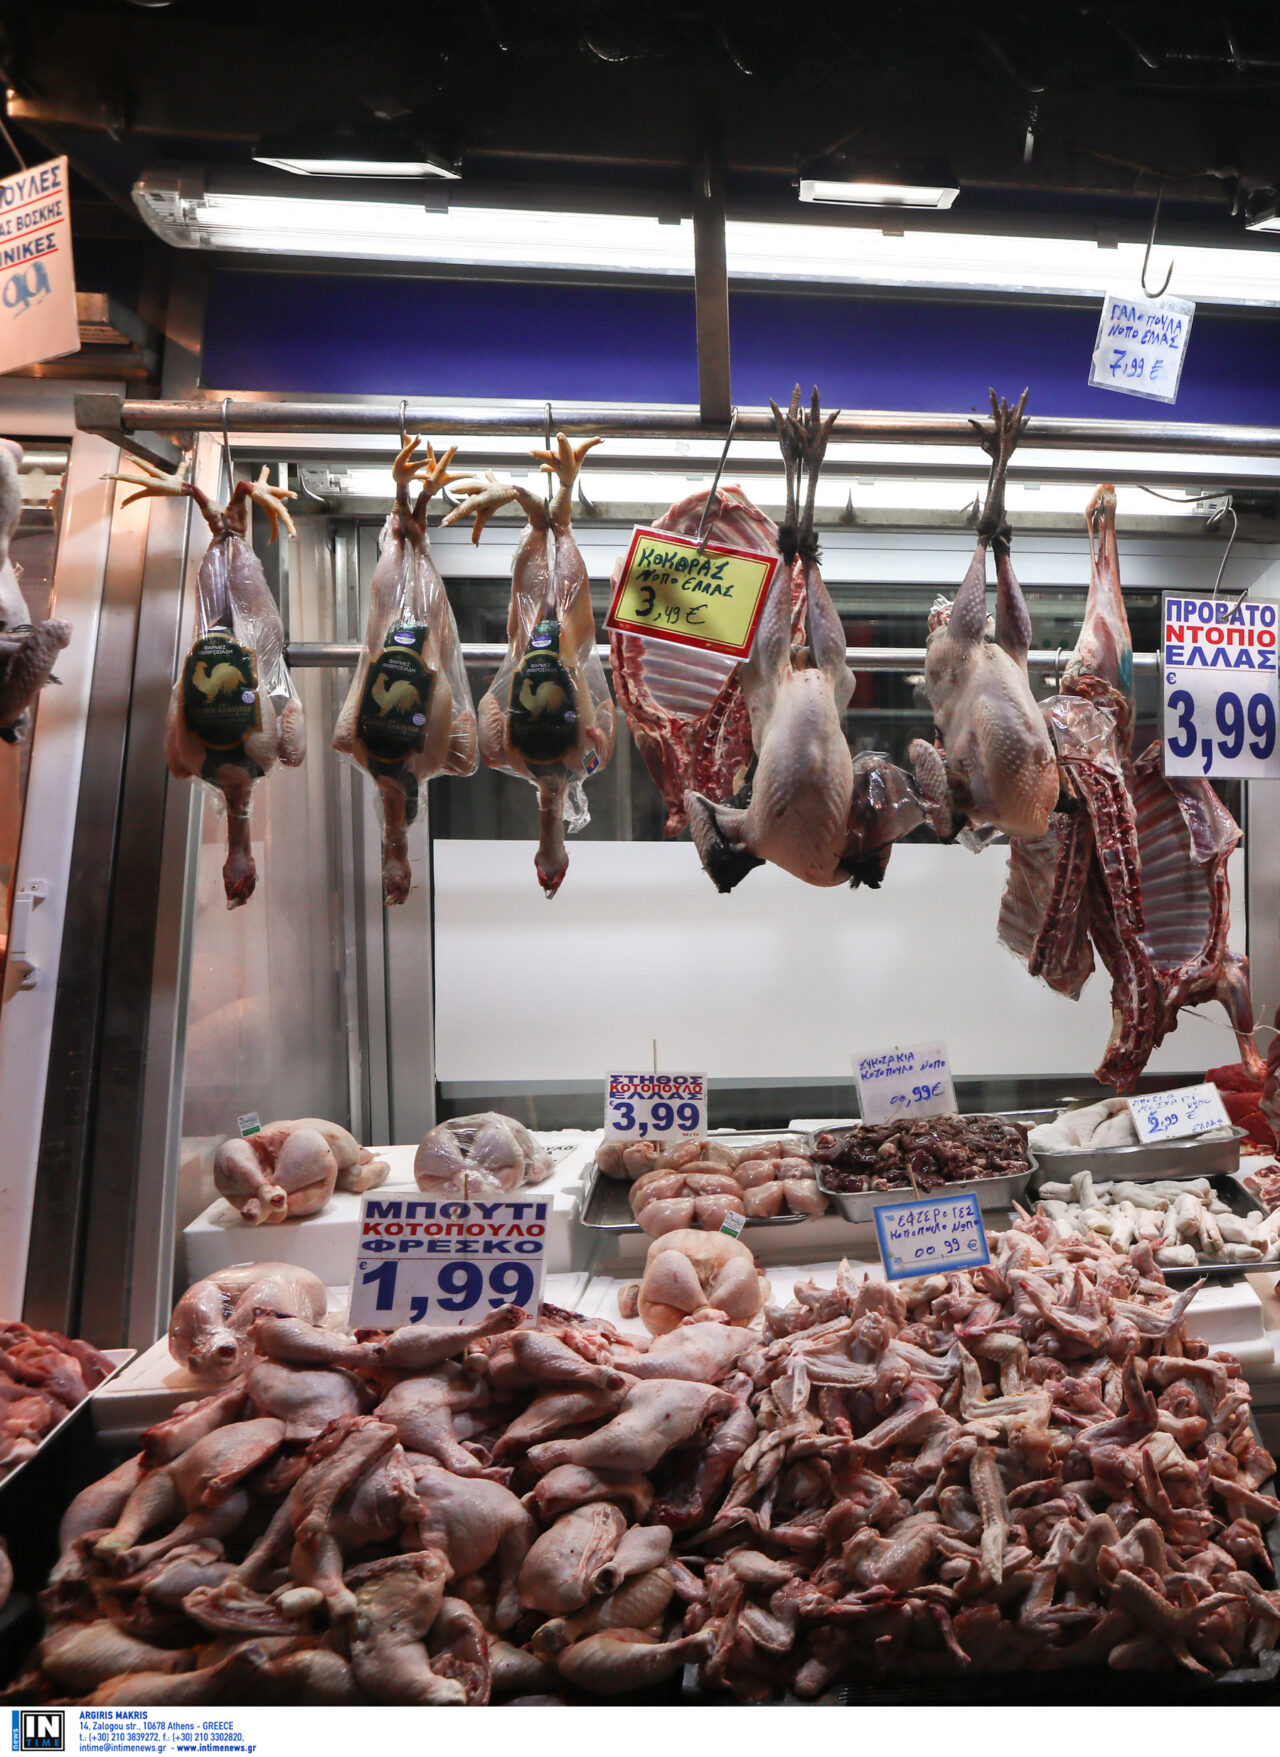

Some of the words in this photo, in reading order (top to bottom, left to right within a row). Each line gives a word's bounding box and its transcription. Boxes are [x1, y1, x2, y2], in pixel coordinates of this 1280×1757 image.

[17, 200, 62, 230] ΒΟΣΚΗΣ
[1110, 349, 1145, 378] 7,99
[635, 586, 681, 624] 3,49
[686, 604, 708, 625] €
[1166, 599, 1276, 628] ΠΡΟΒΑΤΟ
[1166, 625, 1276, 648] ΝΤΟΠΙΟ
[1166, 645, 1276, 670] ΕΛΛΑΣ
[1166, 672, 1177, 685] €
[1167, 689, 1276, 775] 3,99
[609, 1074, 703, 1085] ΣΤΗΘΟΣ
[610, 1083, 703, 1093] ΚΟΤΟΠΟΥΛΟ
[609, 1091, 703, 1100] ΕΛΛΑΣ
[612, 1102, 700, 1137] 3,99
[365, 1201, 547, 1221] ΜΠΟΥΤΙ
[362, 1222, 546, 1237] ΚΟΤΟΠΟΥΛΟ
[361, 1238, 543, 1254] ΦΡΕΣΚΟ
[362, 1260, 534, 1324] 1,99
